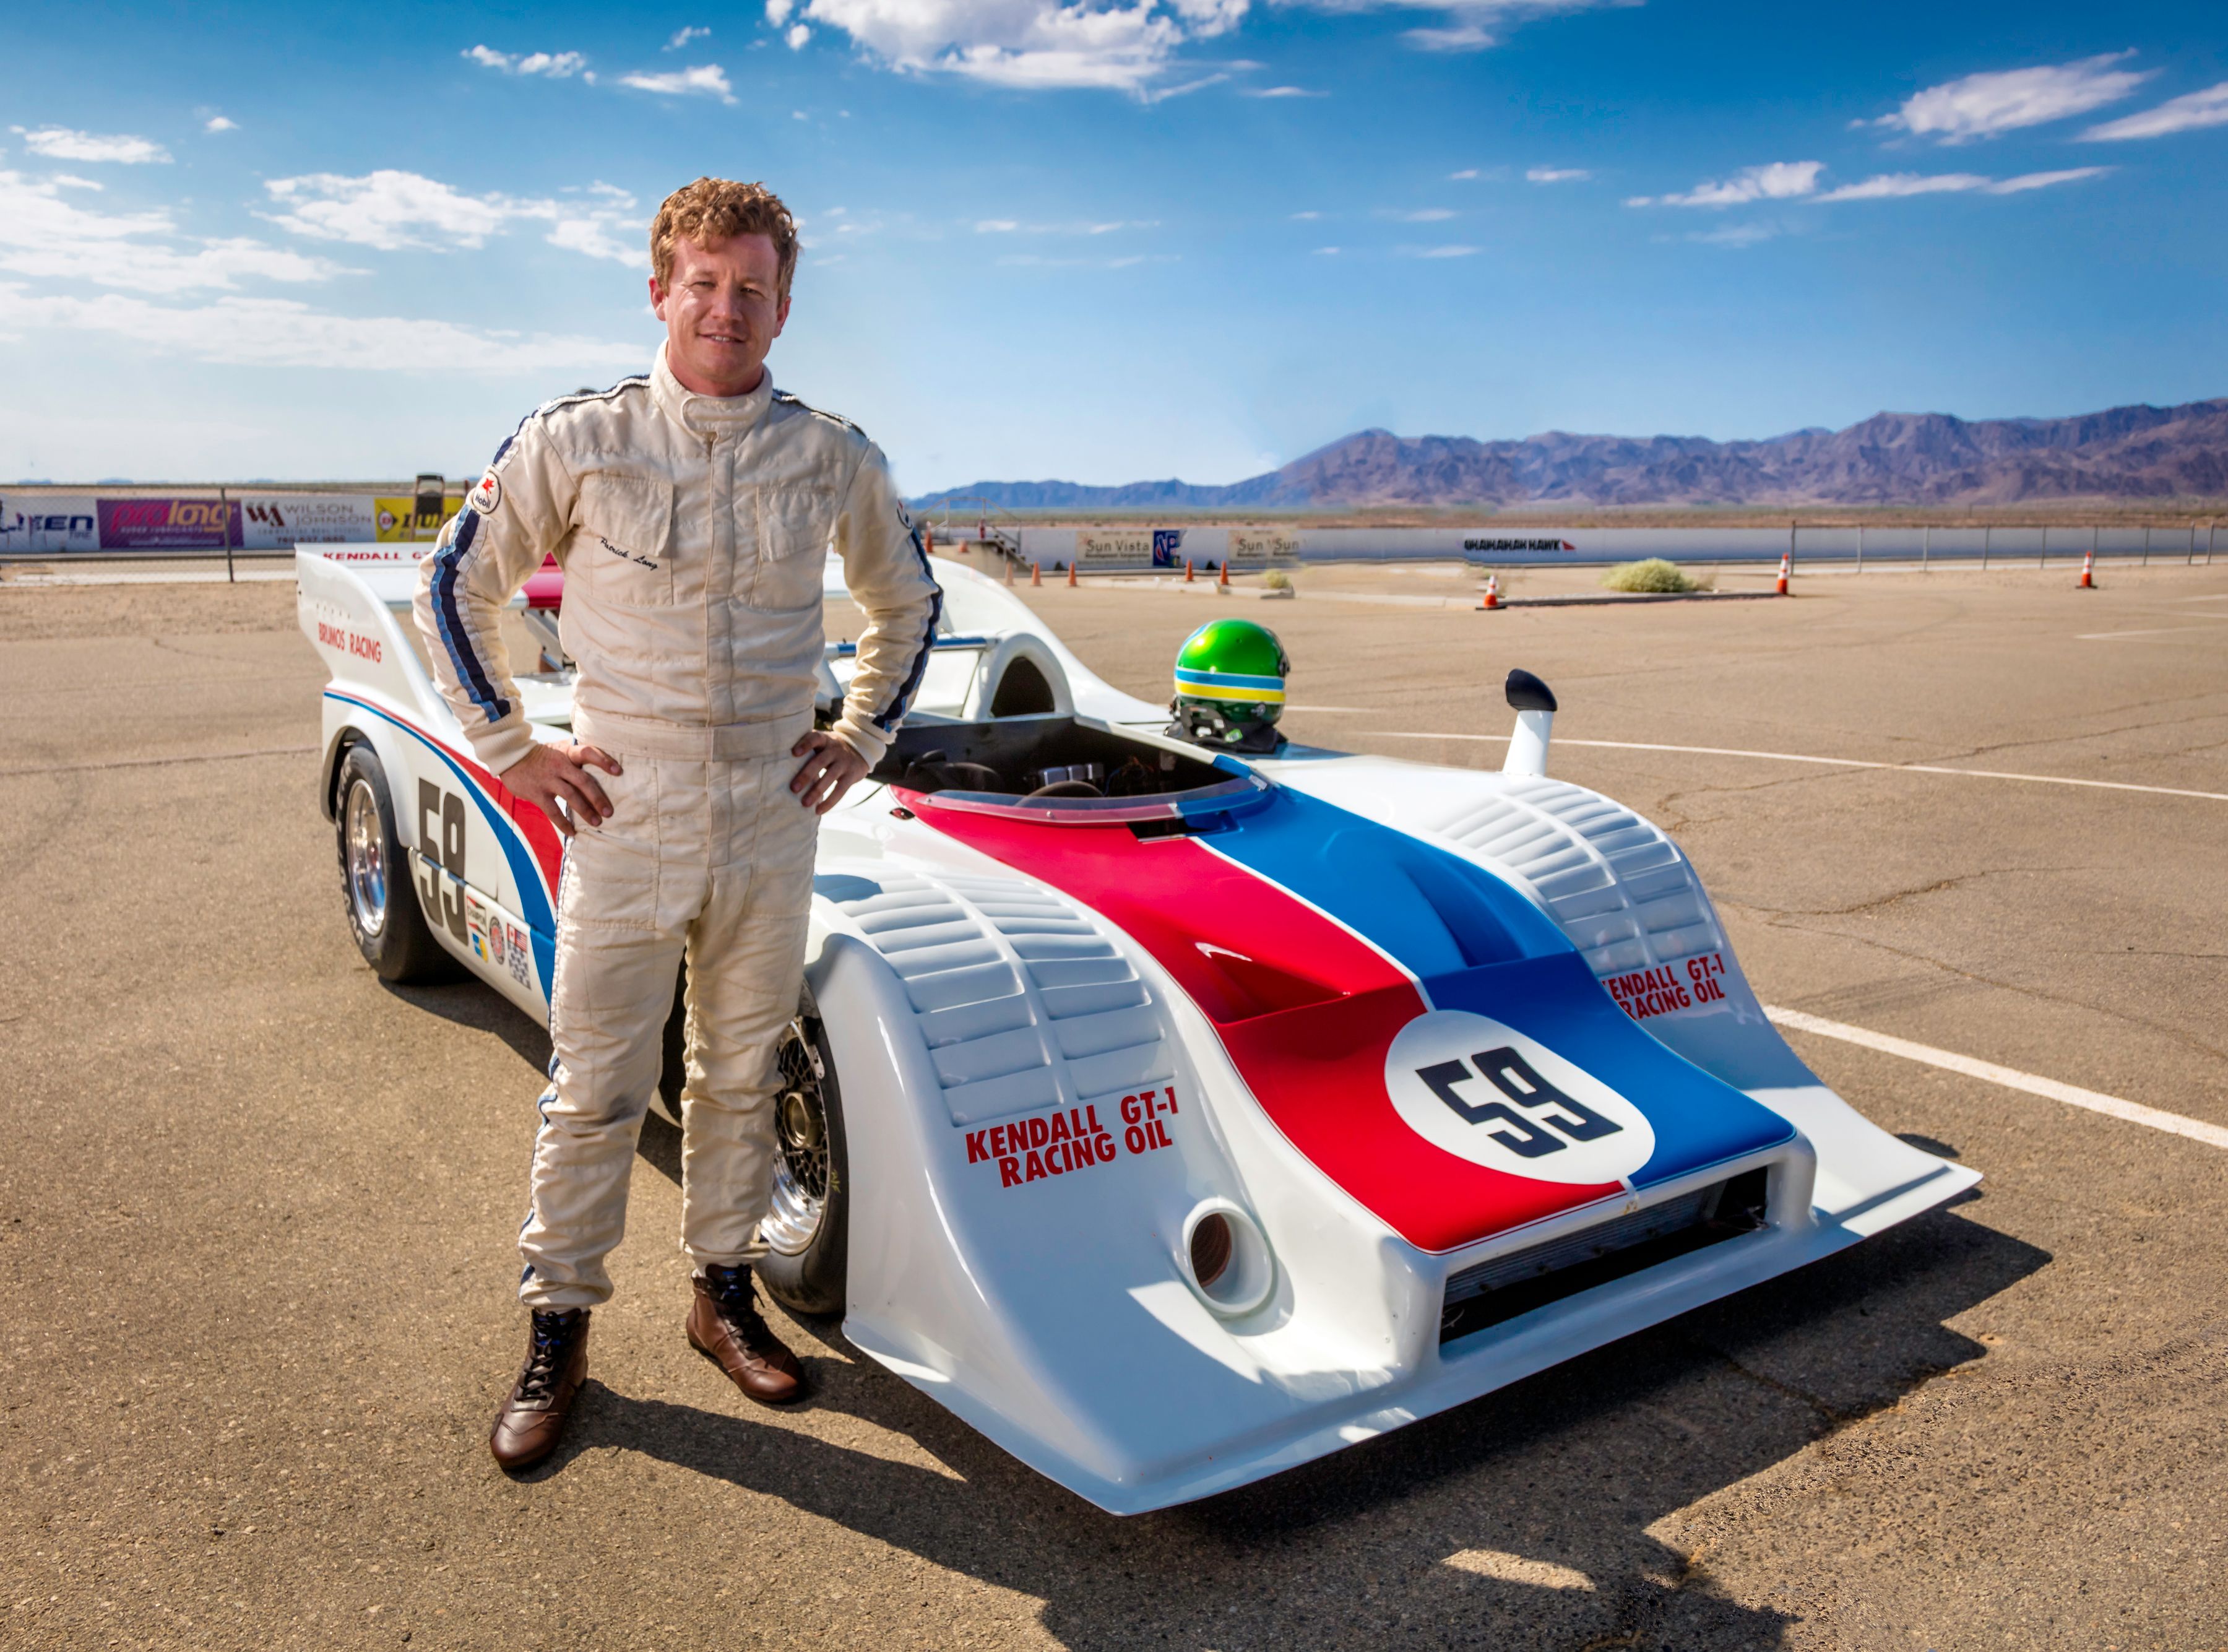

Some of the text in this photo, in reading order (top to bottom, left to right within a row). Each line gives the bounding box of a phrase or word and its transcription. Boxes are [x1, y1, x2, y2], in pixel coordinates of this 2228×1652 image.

[283, 503, 354, 514] WILSON
[475, 494, 491, 509] Mobil
[110, 500, 232, 534] prolong
[296, 514, 371, 527] JOHNSON
[600, 536, 629, 558] Patrick
[1087, 539, 1150, 551] Sun Vista
[1238, 538, 1264, 551] Sun
[1274, 538, 1299, 550] Sun
[323, 552, 402, 561] KENDALL
[318, 621, 381, 664] BRUMOS RACING
[418, 777, 468, 946] 59
[1618, 979, 1725, 1020] RACING OIL
[1415, 1046, 1623, 1158] 59
[965, 1086, 1179, 1164] KENDALL GT-1
[998, 1119, 1173, 1188] RACING OIL
